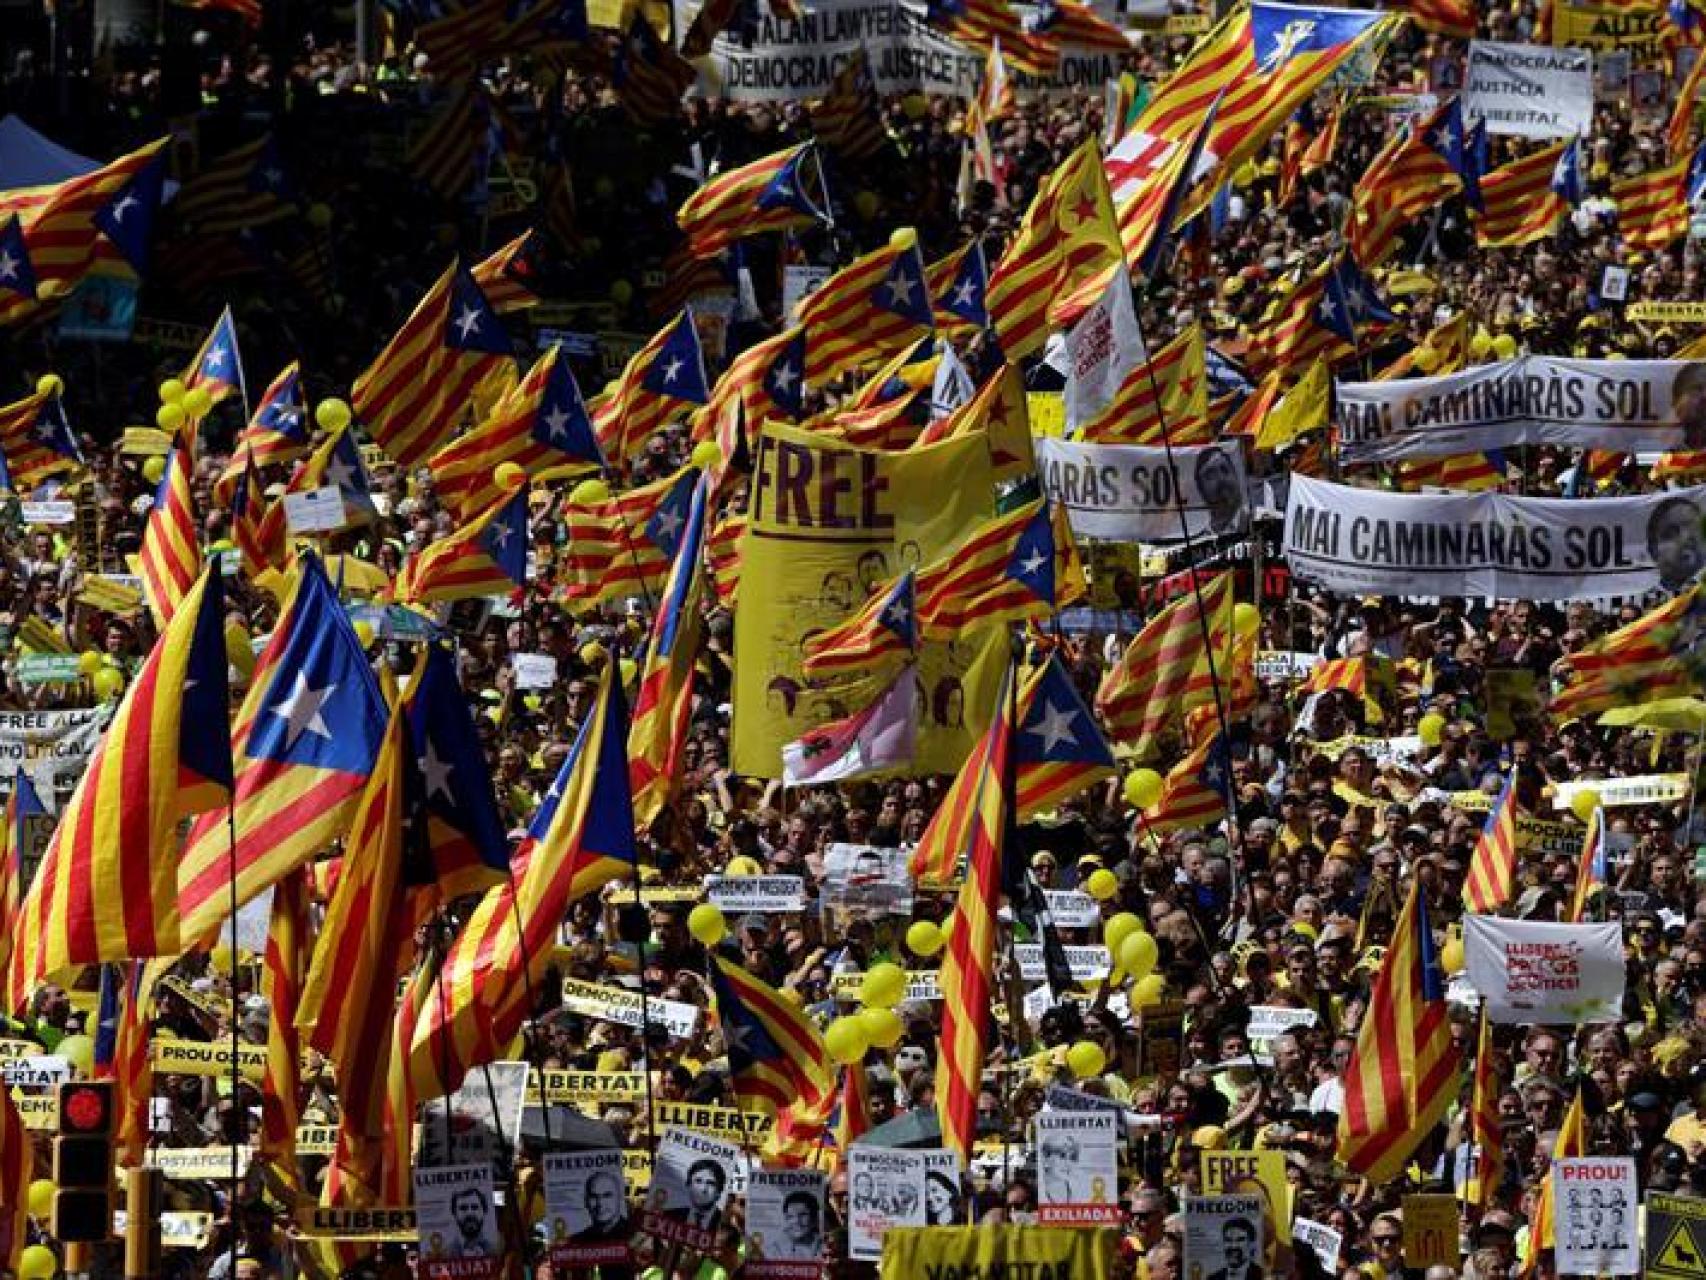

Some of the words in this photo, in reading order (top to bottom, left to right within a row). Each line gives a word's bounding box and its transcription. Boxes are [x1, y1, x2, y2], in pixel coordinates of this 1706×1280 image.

[1337, 400, 1393, 441] MAI
[1596, 377, 1660, 420] SOL
[753, 436, 896, 528] FREE
[1291, 503, 1342, 557] MAI
[1350, 512, 1552, 568] CAMINARÀS
[1563, 525, 1633, 568] SOL
[163, 1046, 212, 1061] PROU
[1039, 1116, 1112, 1130] LLIBERTAT
[665, 1128, 735, 1161] FREEDOM
[546, 1153, 620, 1171] FREEDOM
[416, 1167, 489, 1187] LLIBERTAT
[750, 1170, 822, 1187] FREEDOM
[1563, 1165, 1627, 1180] PROU!
